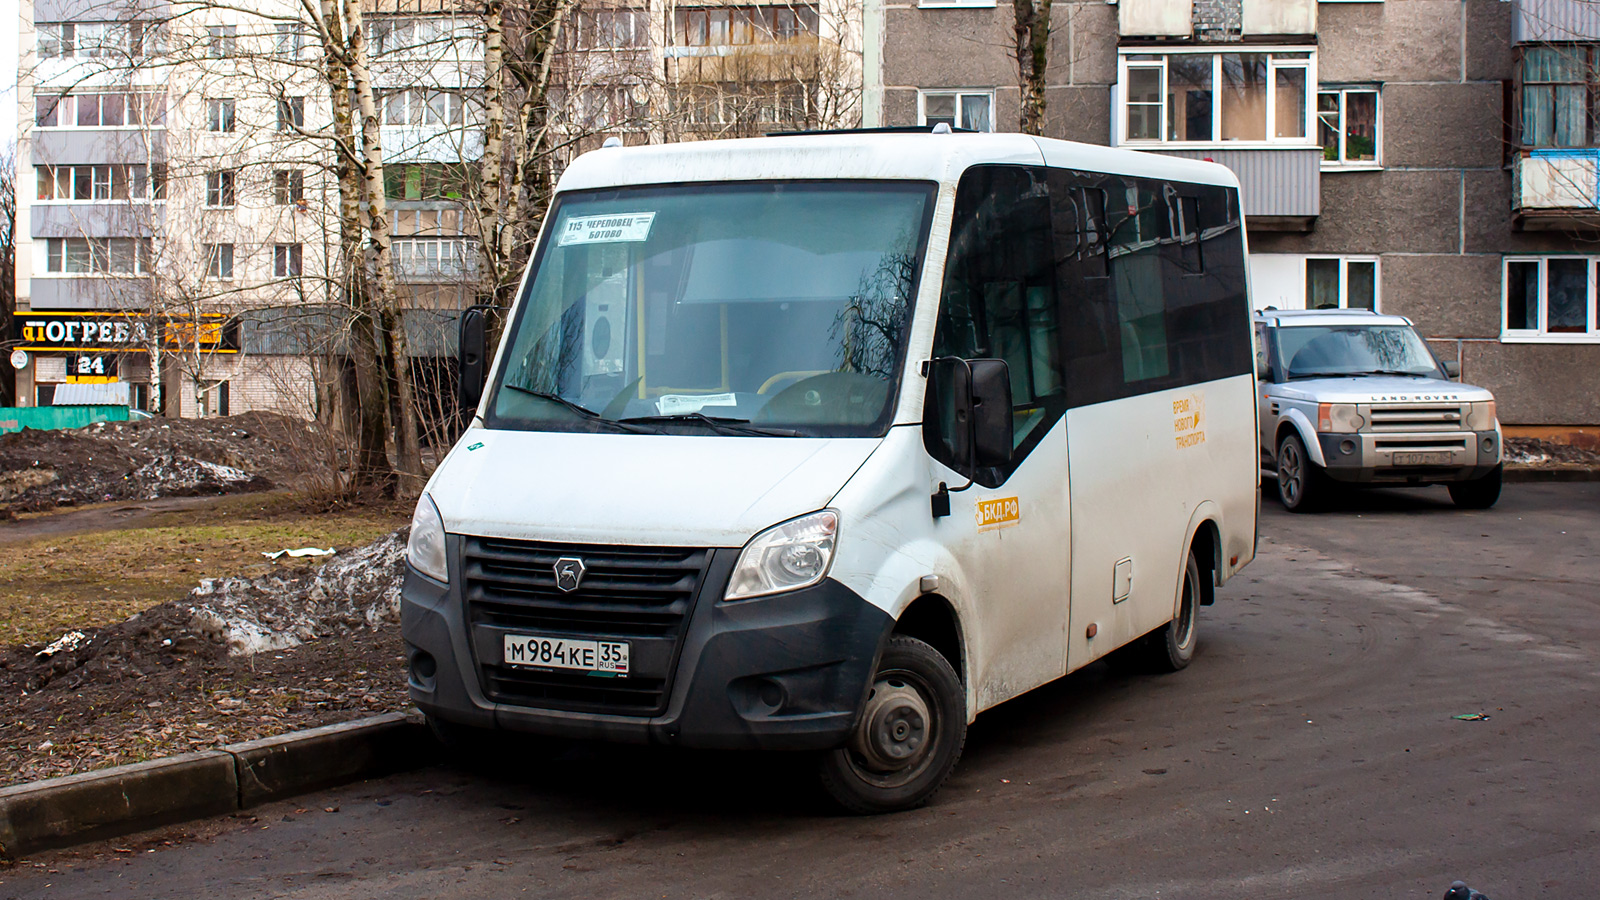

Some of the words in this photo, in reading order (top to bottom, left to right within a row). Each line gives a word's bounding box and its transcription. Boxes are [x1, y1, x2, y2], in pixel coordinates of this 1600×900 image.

[568, 221, 583, 231] 115
[586, 218, 633, 229] ЧЕРЕПОВЕЦ
[588, 229, 622, 239] БОТОВО
[78, 356, 104, 374] 24
[1173, 399, 1189, 414] ВРЕМЯ
[1174, 416, 1193, 432] НОВОГО
[1175, 431, 1206, 450] ТРАНСПОРТА
[984, 500, 1017, 521] БКД.РФ
[511, 639, 594, 667] М984КЕ
[601, 644, 621, 661] 35
[599, 661, 615, 669] RUS
